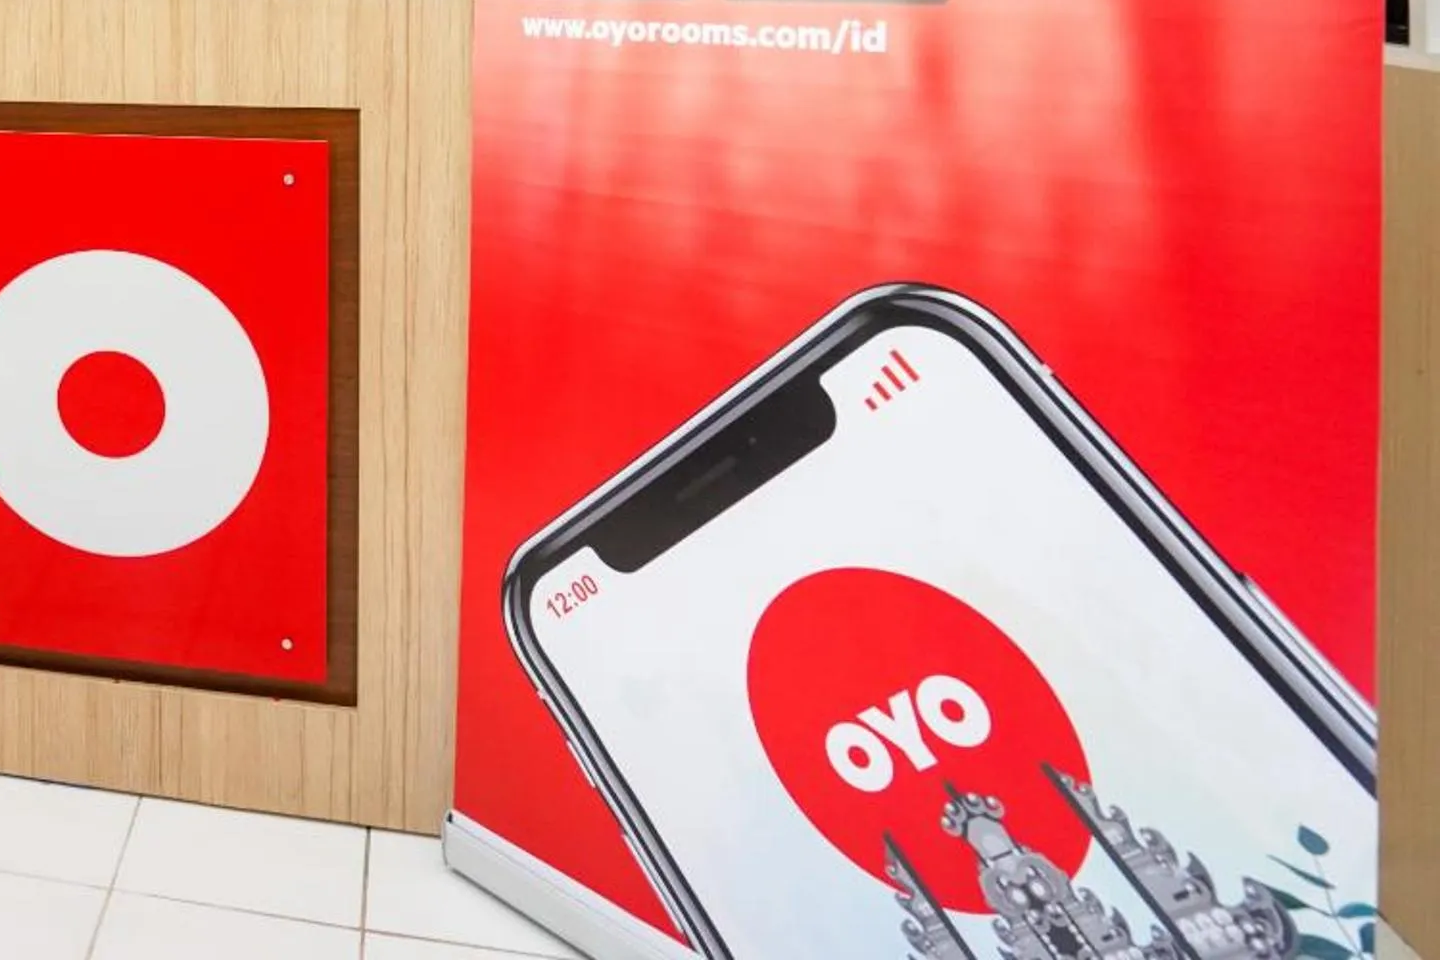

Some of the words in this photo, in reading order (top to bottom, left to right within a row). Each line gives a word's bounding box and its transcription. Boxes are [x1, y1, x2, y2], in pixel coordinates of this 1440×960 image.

[522, 16, 888, 54] www.oyorooms.com/id
[545, 574, 600, 620] 12:00
[825, 674, 993, 793] OYO
